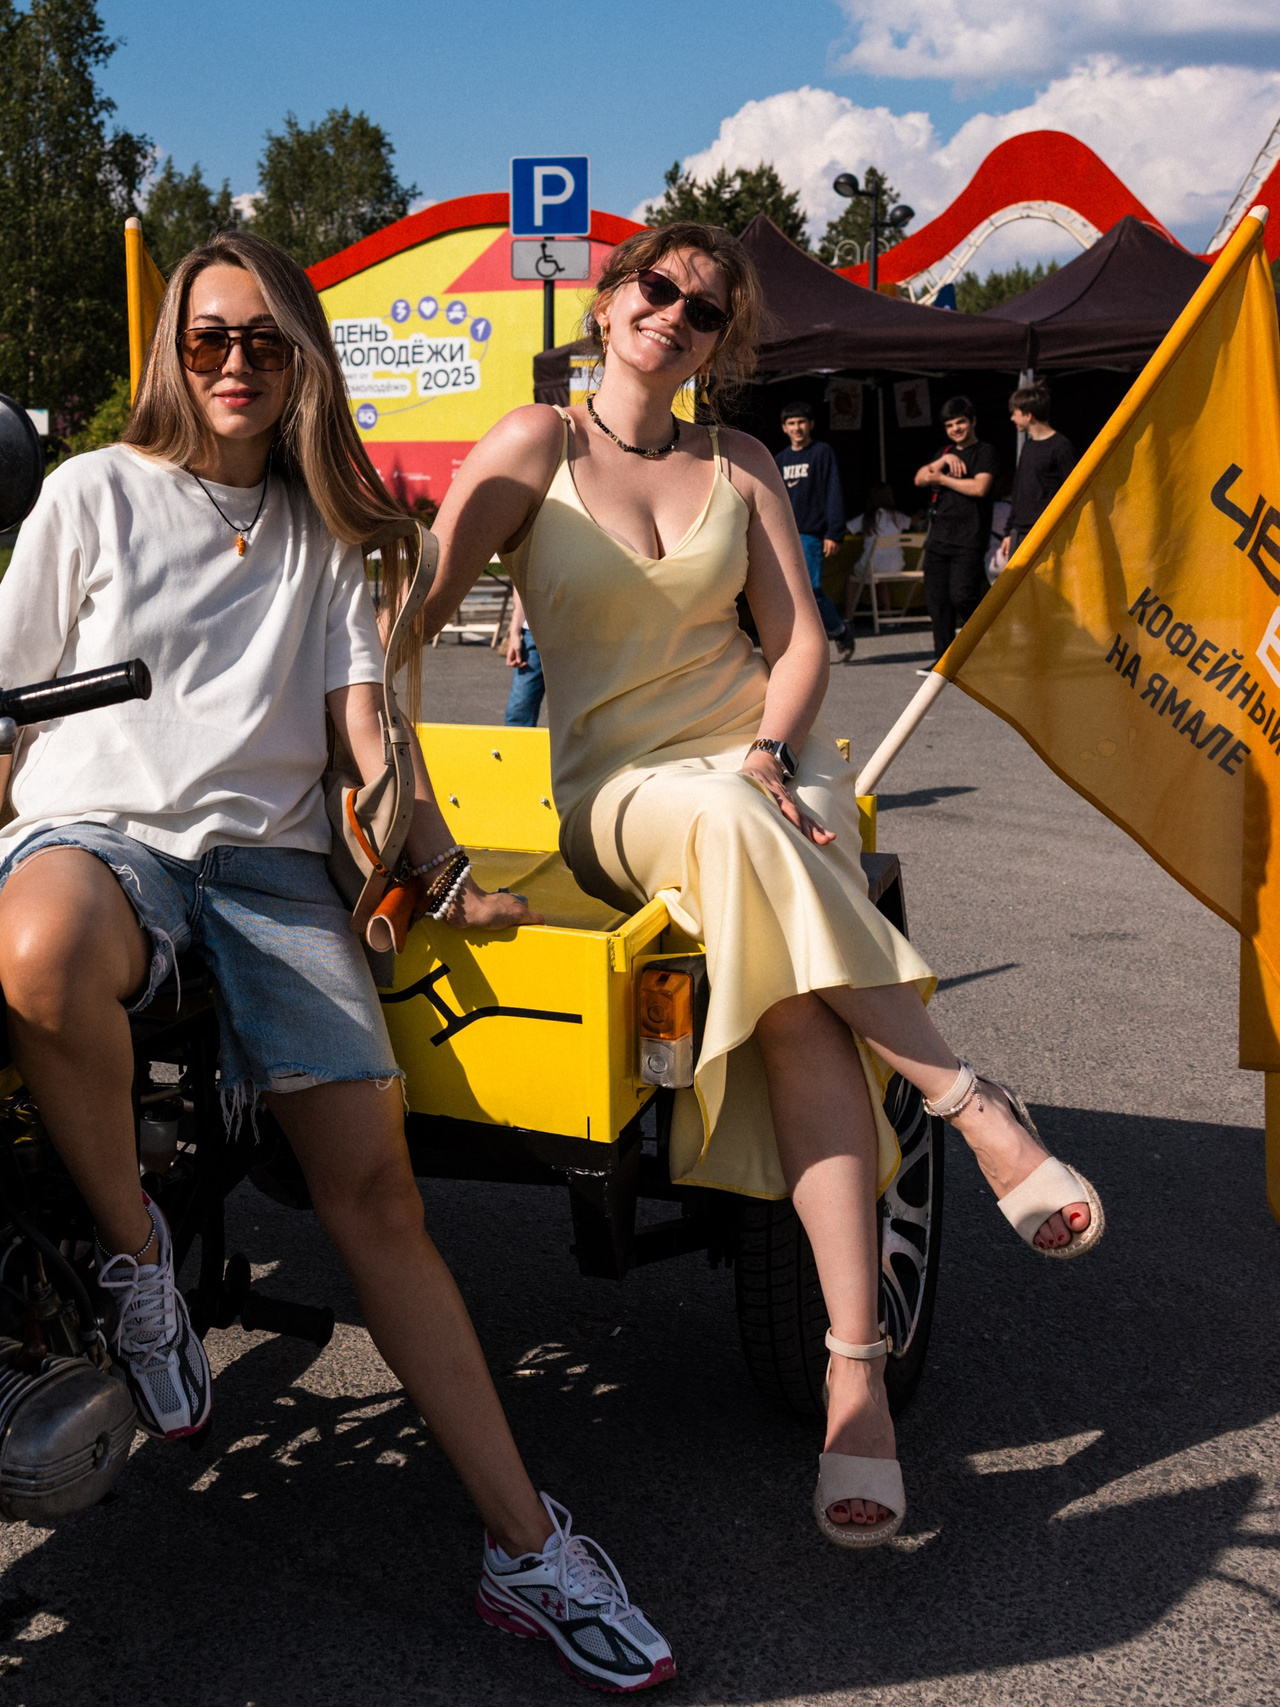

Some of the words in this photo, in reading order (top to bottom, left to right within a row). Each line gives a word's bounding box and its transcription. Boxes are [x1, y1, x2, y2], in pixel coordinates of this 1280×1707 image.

[534, 166, 575, 226] P
[334, 324, 388, 346] ДЕНЬ
[337, 340, 464, 368] МОЛОДЁЖИ
[422, 366, 475, 390] 2025
[783, 463, 809, 480] NIKE
[1105, 633, 1141, 689] НА
[1140, 673, 1252, 775] ЯМАЛЕ
